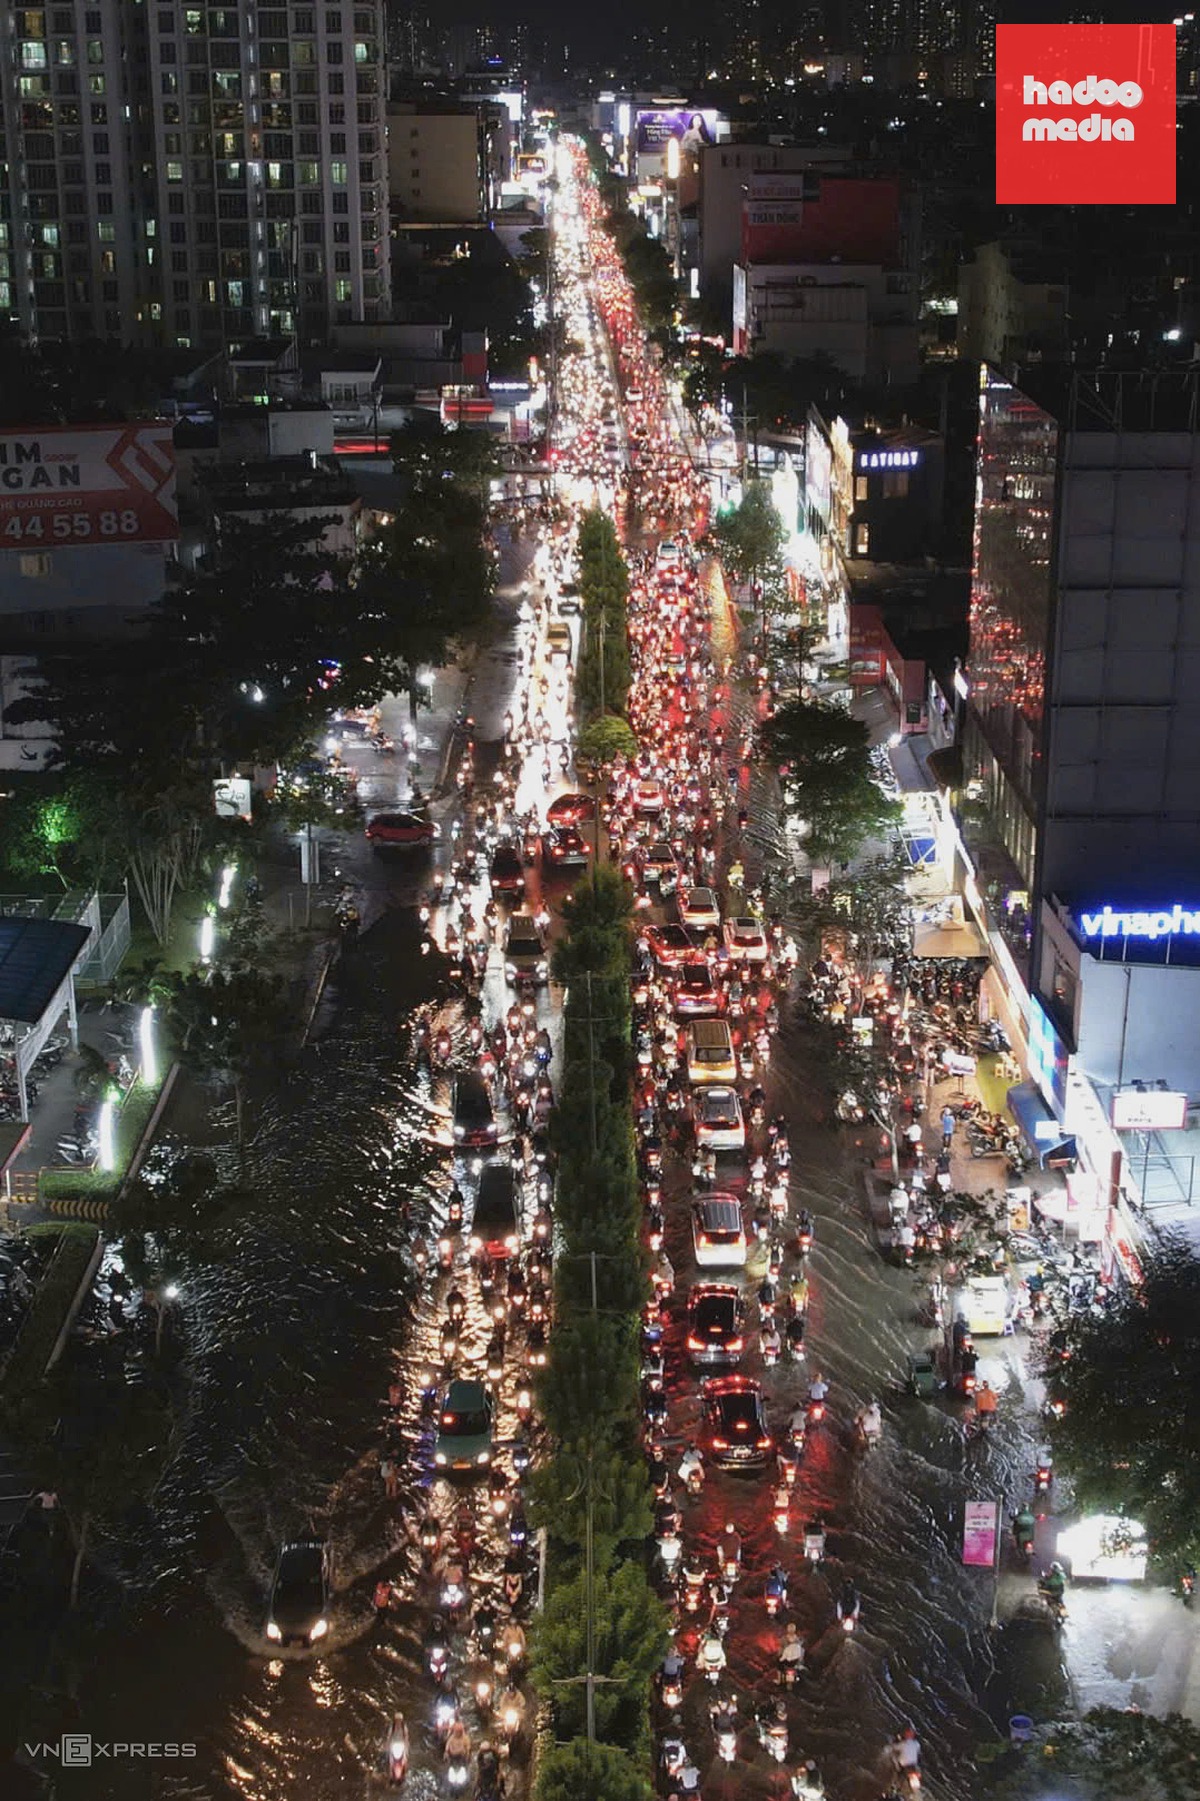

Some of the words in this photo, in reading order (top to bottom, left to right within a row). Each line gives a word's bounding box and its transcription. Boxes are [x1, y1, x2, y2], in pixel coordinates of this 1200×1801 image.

[5, 516, 44, 539] 44
[53, 513, 92, 537] 55
[100, 510, 140, 534] 88
